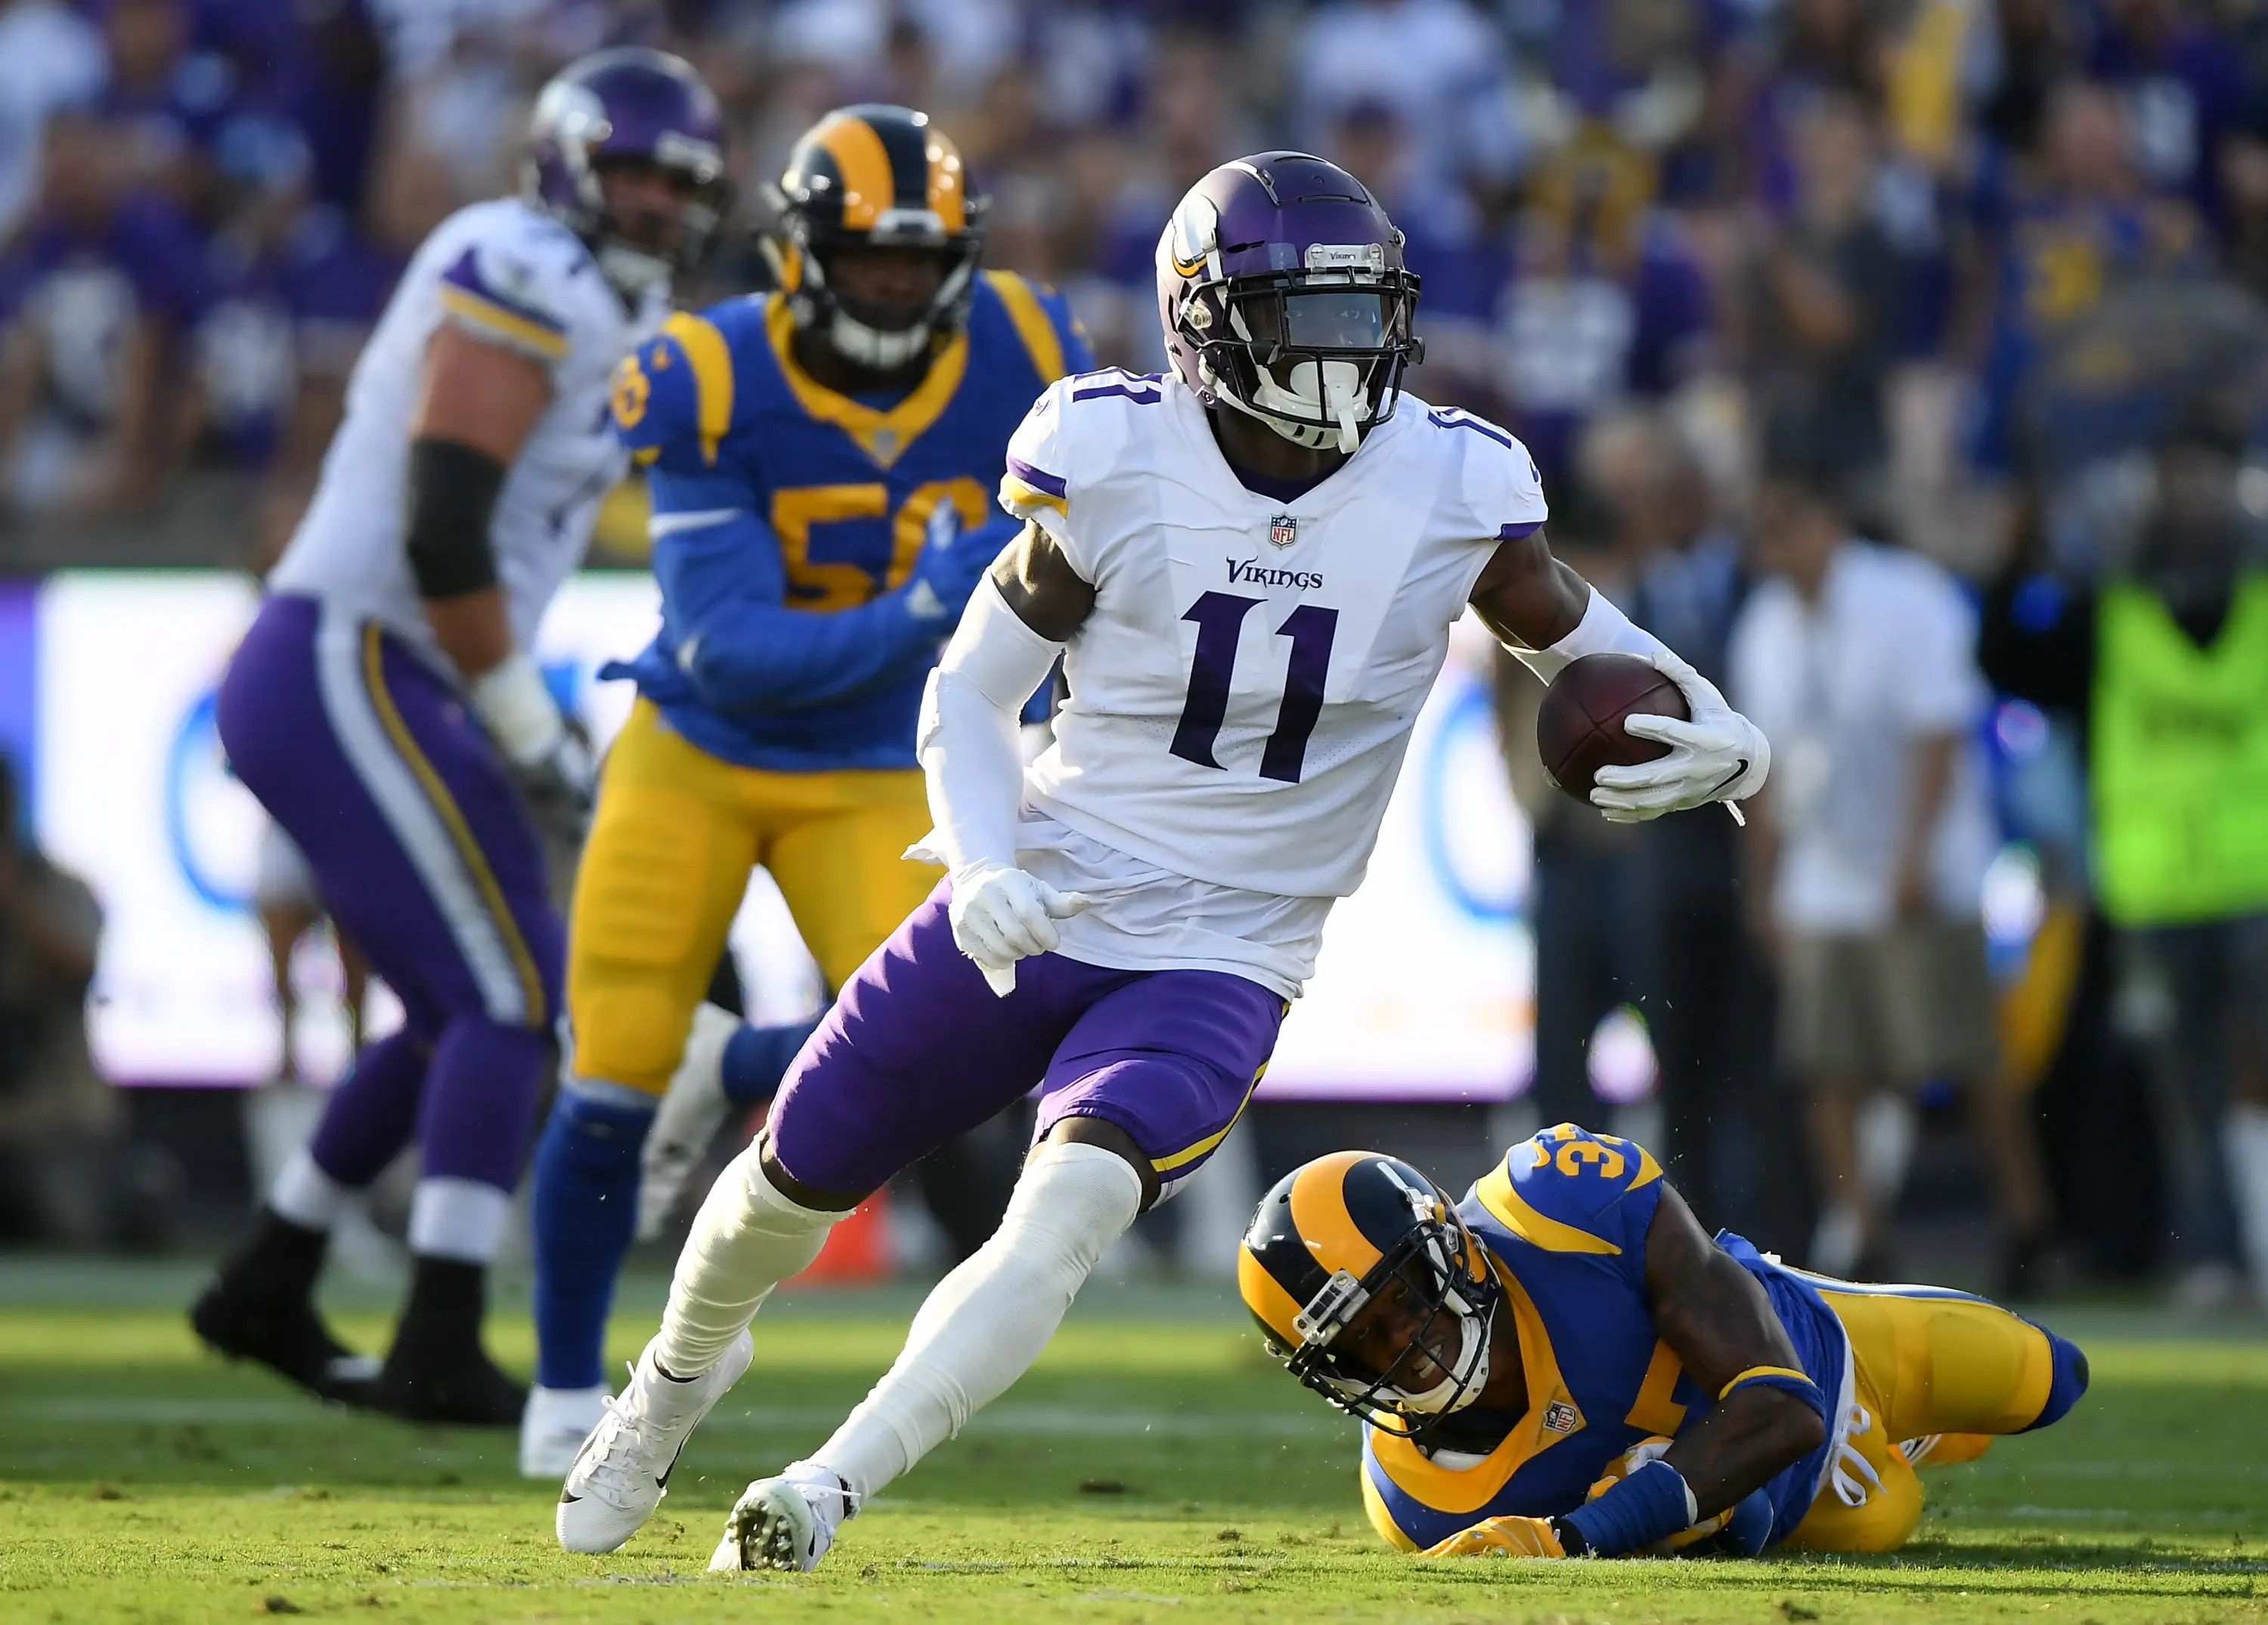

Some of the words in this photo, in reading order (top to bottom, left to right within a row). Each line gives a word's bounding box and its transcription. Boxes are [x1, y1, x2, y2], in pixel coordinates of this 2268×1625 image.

[1272, 527, 1294, 543] NFL
[1169, 590, 1340, 784] 11
[1556, 1409, 1573, 1430] NFL
